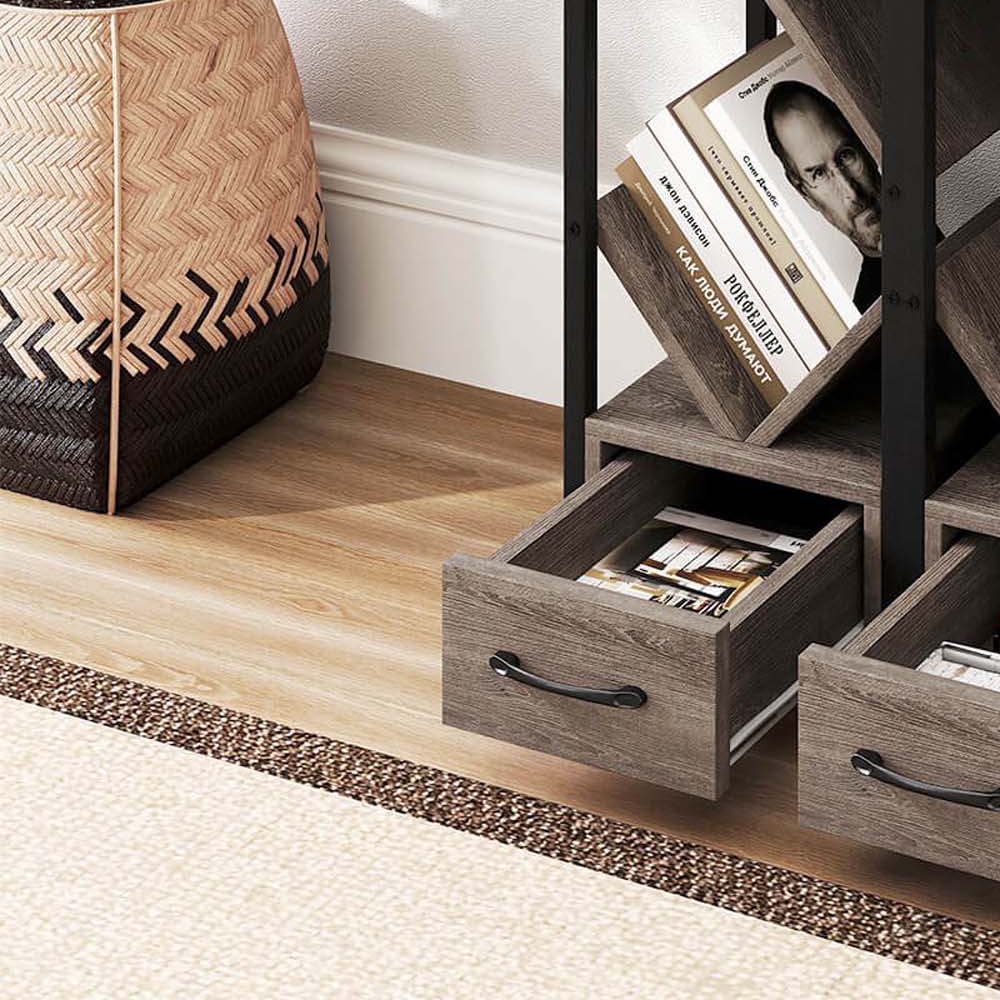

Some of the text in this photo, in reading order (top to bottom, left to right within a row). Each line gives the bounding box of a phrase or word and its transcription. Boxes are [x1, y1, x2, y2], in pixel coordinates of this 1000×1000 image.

[675, 246, 773, 386] КАК ЛЮДИ ДУМАЮТ
[723, 273, 784, 357] РОКФЕЛЛЕР
